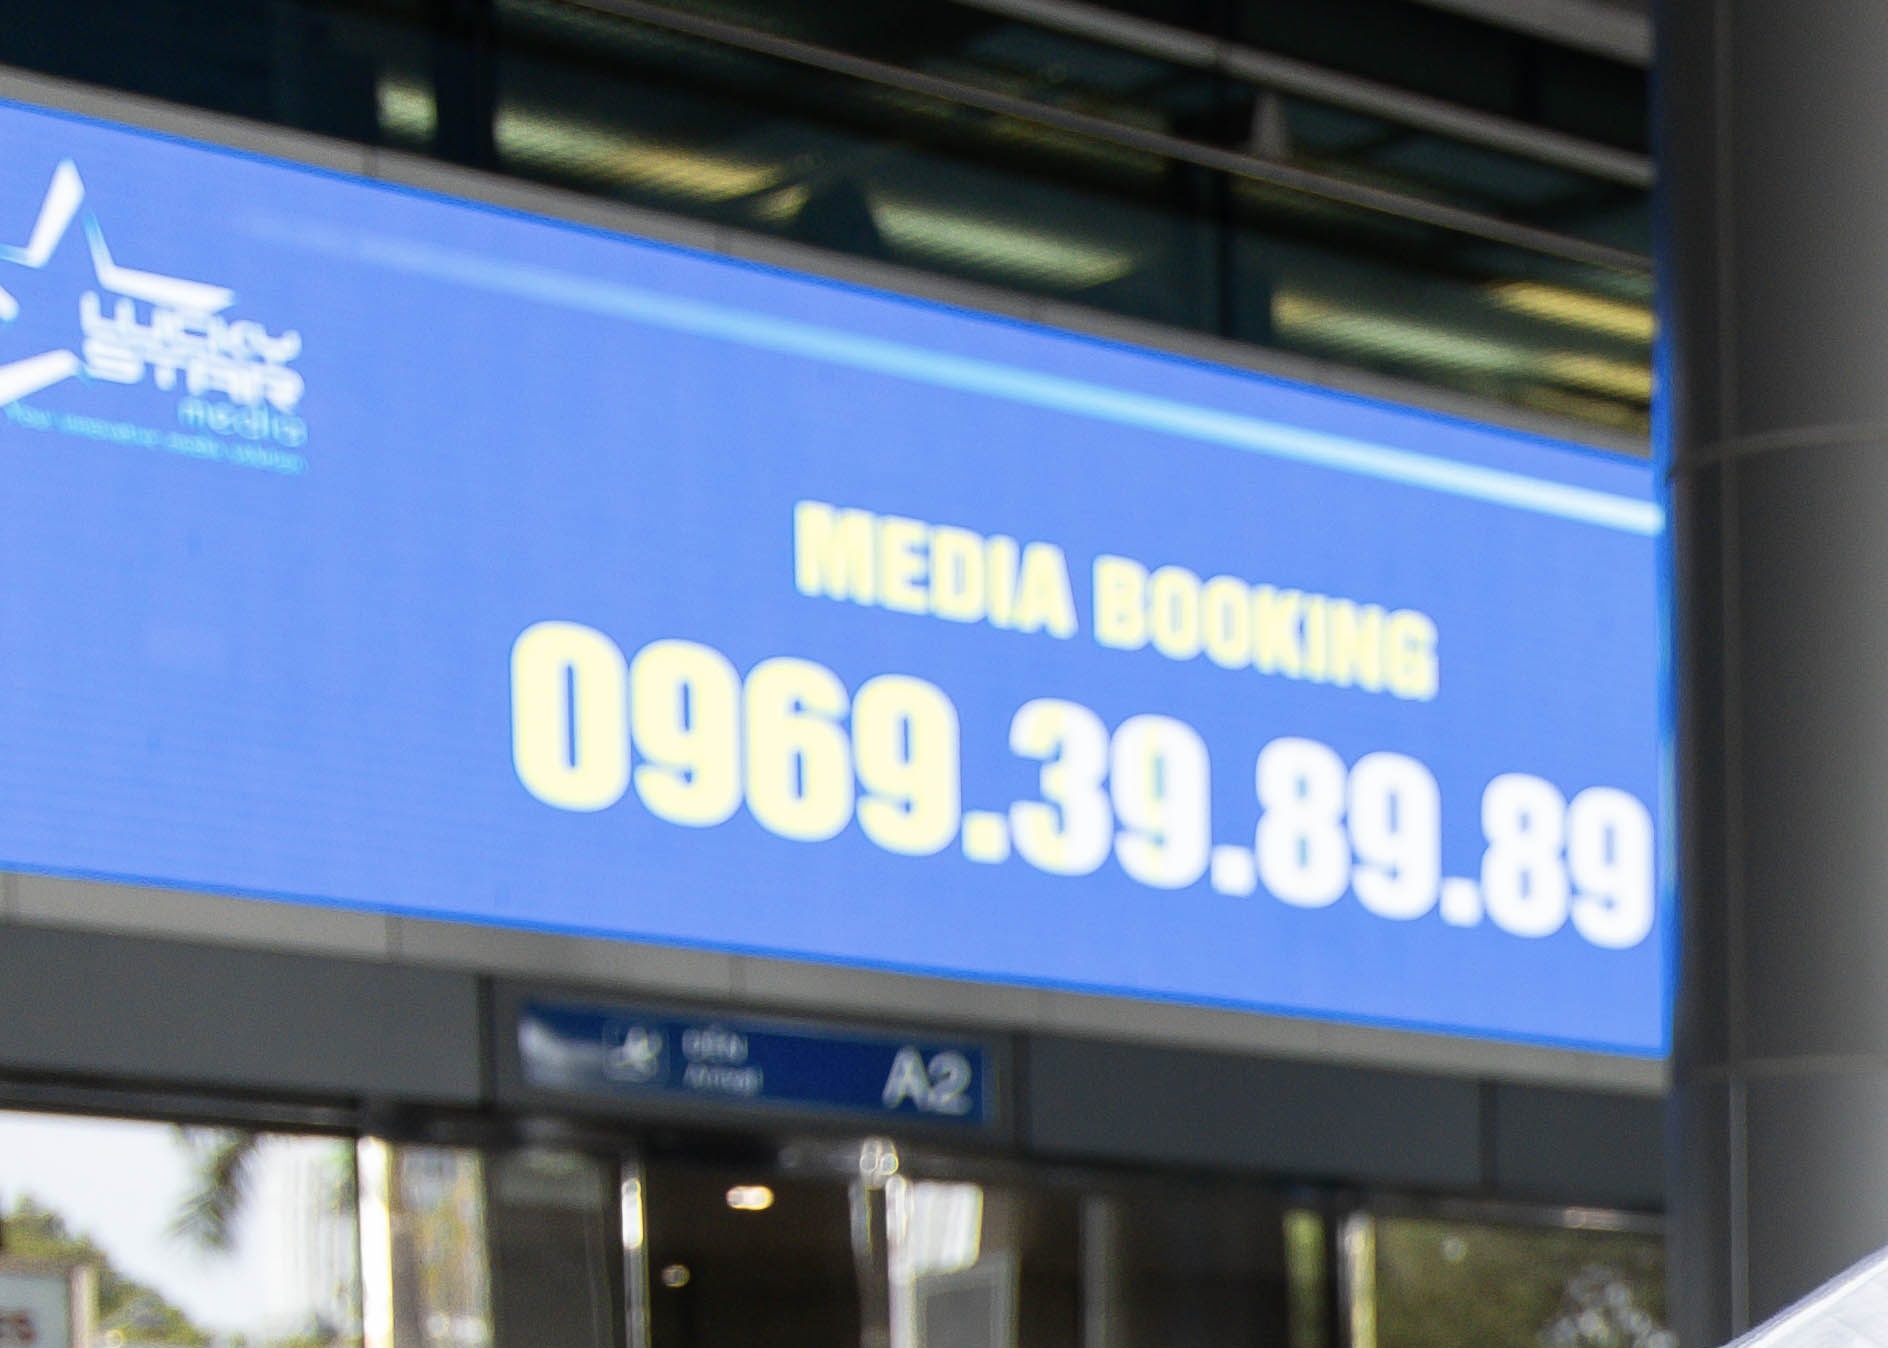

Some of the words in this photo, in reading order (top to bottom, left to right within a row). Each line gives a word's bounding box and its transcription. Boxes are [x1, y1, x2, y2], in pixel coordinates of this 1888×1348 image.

[795, 500, 1077, 640] MEDIA
[1092, 554, 1438, 703] BOOKING
[511, 620, 1657, 949] 0969.39.89.89
[881, 1045, 973, 1116] A2
